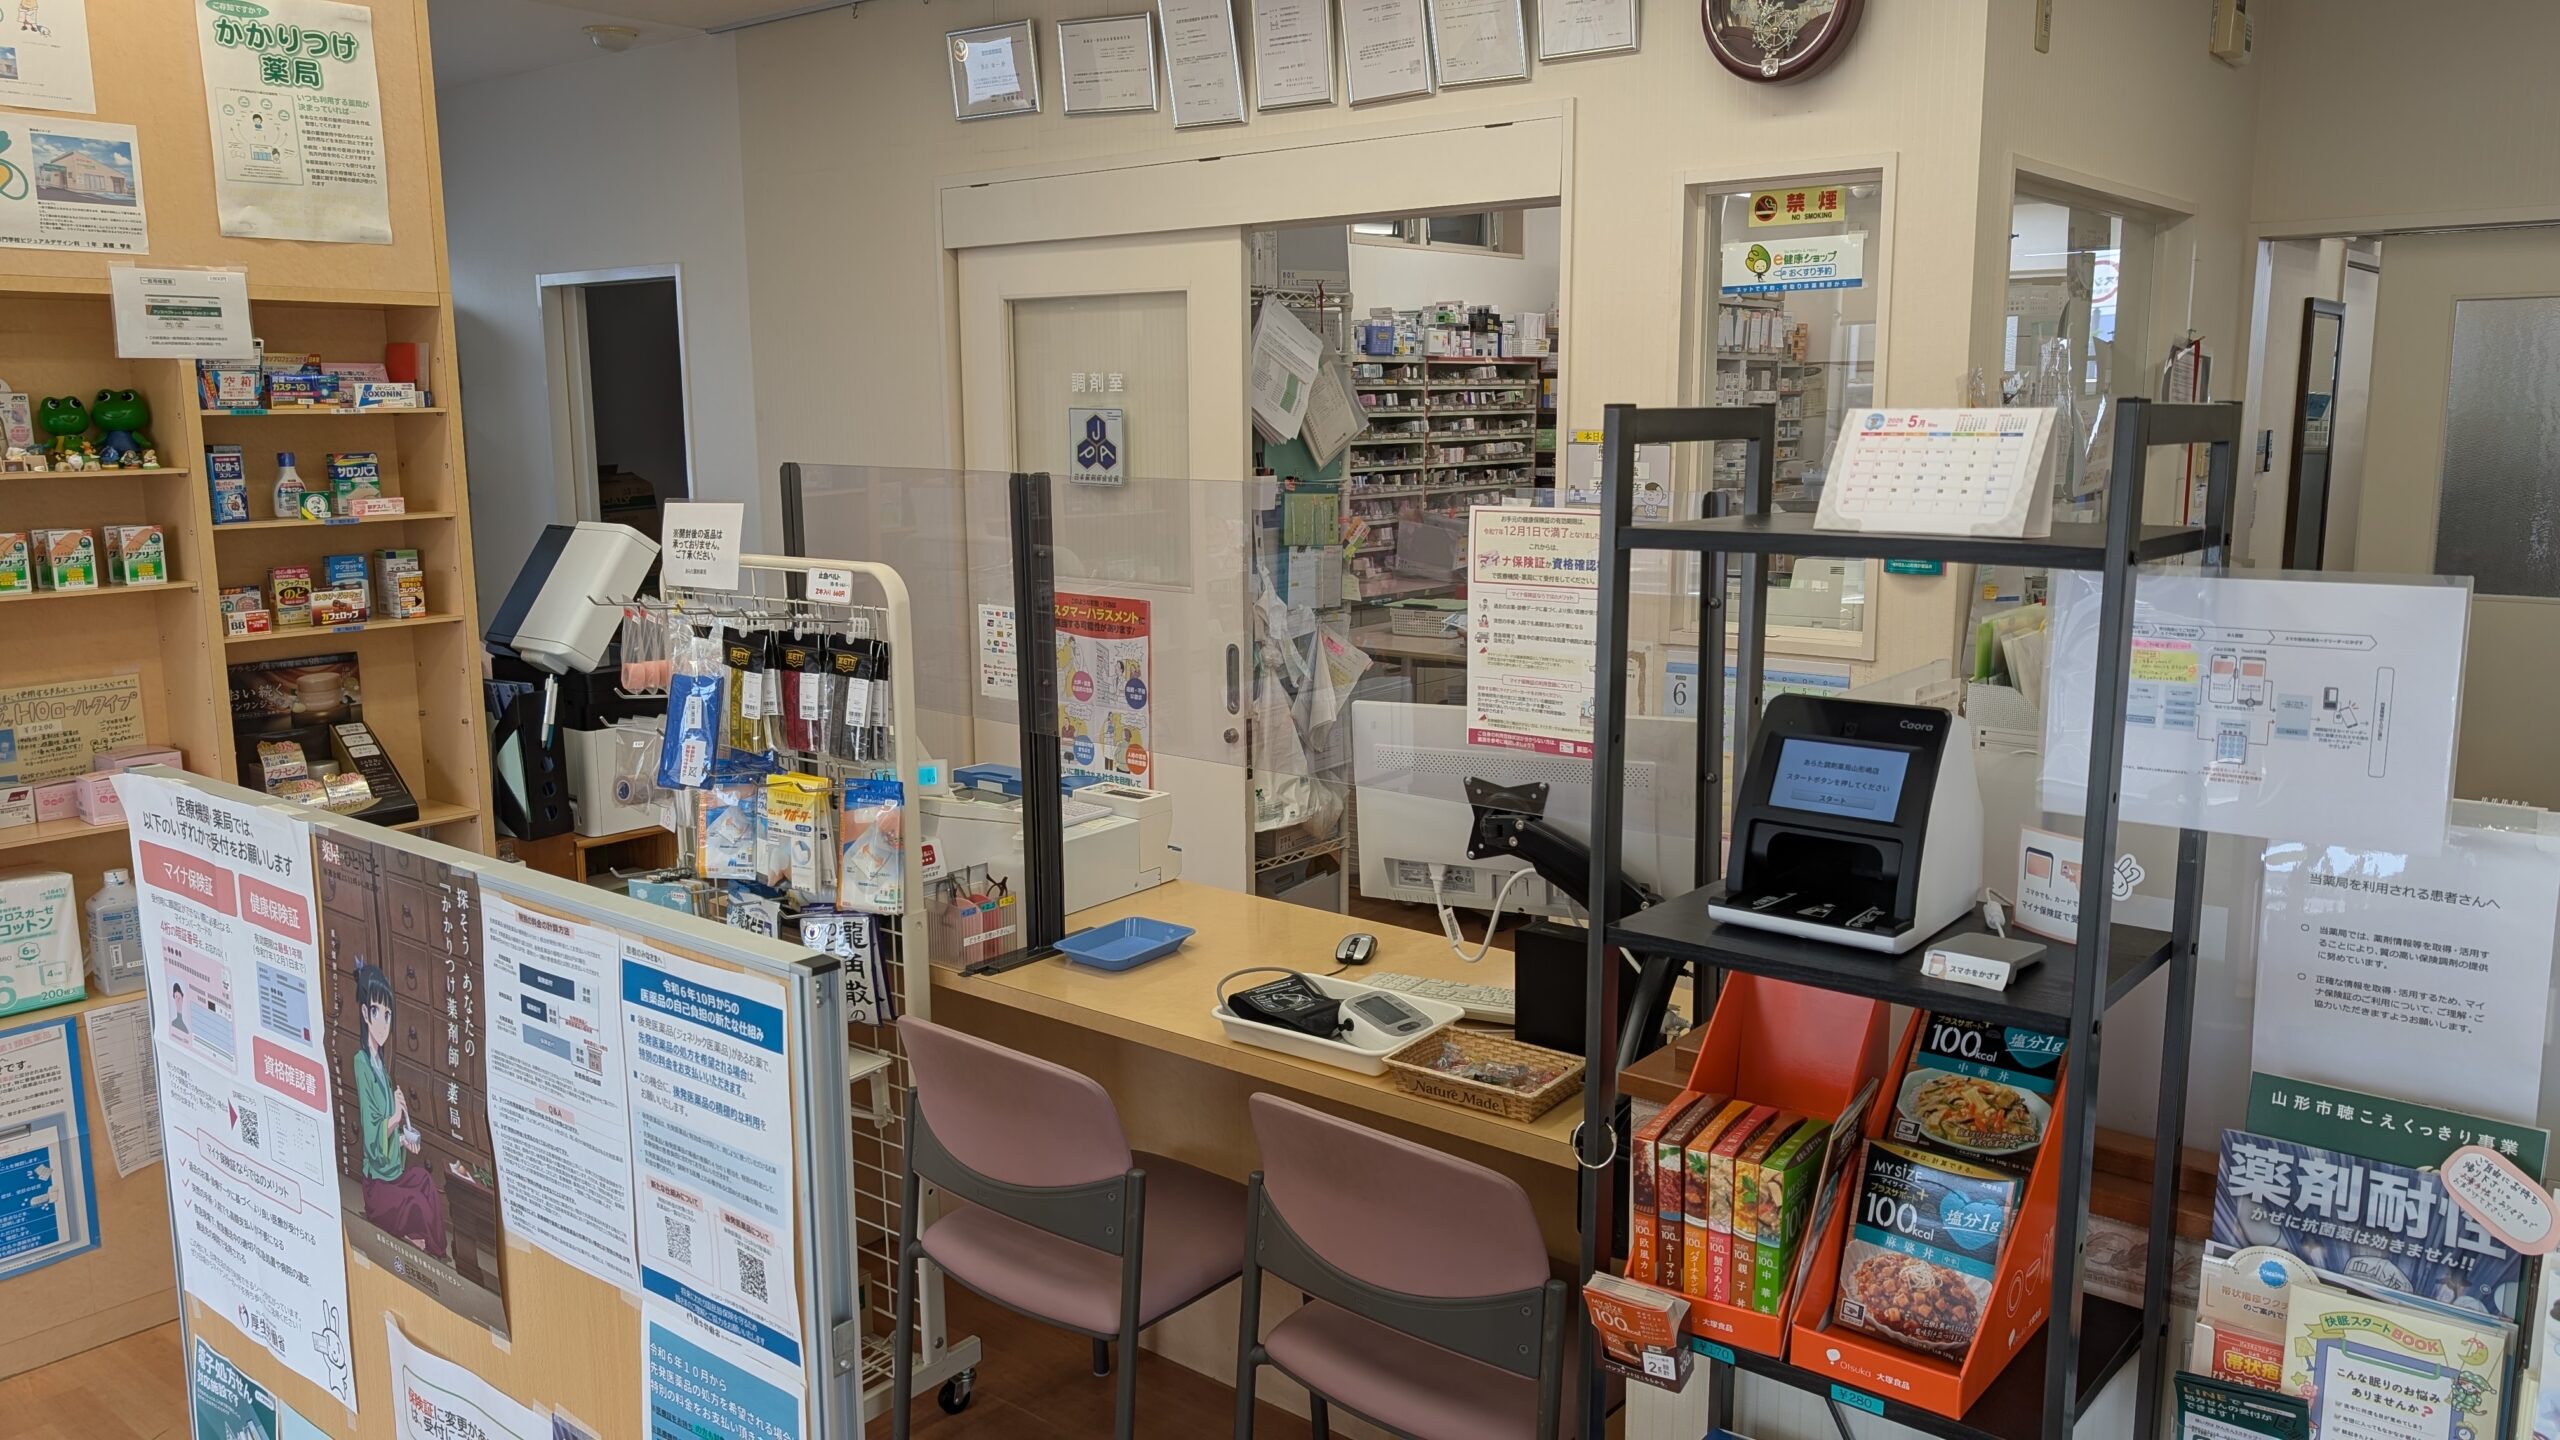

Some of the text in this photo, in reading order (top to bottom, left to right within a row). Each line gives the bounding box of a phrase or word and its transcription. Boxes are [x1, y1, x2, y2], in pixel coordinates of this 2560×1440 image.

[215, 18, 357, 60] かかりつけ
[261, 55, 321, 87] 薬局
[1786, 190, 1838, 213] 禁煙
[1804, 212, 1833, 221] SMOKING
[1773, 250, 1838, 266] e健康ショップ
[1282, 271, 1296, 279] BOX
[1788, 266, 1833, 278] おくすり予約
[1282, 279, 1300, 287] FILE
[1071, 372, 1124, 393] 調剤室
[363, 390, 402, 398] LOXONIN
[1907, 415, 1927, 428] 5月
[338, 466, 377, 478] サロンパス
[1501, 516, 1586, 525] お手元の健康保険証の有効期限は、
[672, 528, 723, 540] ※開封後の返品は
[672, 540, 720, 550] 承っておりません。
[675, 550, 717, 561] ご了承ください。
[1528, 543, 1559, 551] これからは、
[1479, 554, 1600, 571] マイナ保険証か資格確認
[284, 588, 307, 600] のど
[231, 621, 245, 630] BB
[731, 648, 750, 660] ZETT
[786, 650, 805, 662] ZETT
[836, 655, 857, 666] ZETT
[1673, 681, 1687, 706] 6
[1900, 720, 1934, 731] Caora
[265, 766, 306, 778] プラセンタ
[1786, 773, 1890, 792] スタートボタンを押してください
[1819, 795, 1847, 805] スタート
[163, 861, 214, 897] マイナ保険証
[2309, 873, 2501, 909] 当薬局を利用される患者さんへ
[250, 892, 301, 930] 健康保険証
[2319, 926, 2489, 959] 当薬局では、薬剤情報等を取得・活用す
[2317, 951, 2388, 970] に努めています。
[2318, 938, 2489, 973] ることにより、質の高い保険調剤の提供
[455, 888, 476, 1057] 探そう、あなたの
[1950, 965, 2001, 981] スマホをかざす
[662, 980, 740, 1016] 令和6年10月からの
[2316, 975, 2485, 1010] 正確な情報を取得・活用するため、マイ
[640, 989, 765, 1042] 医薬品の自己負担の新たな仕組み
[2315, 987, 2485, 1024] ナ保険証のご利用について、ご理解・ご
[2314, 1000, 2473, 1034] 協力いただきますようお願いします。
[1931, 1023, 1998, 1063] 100kcal
[2008, 1034, 2065, 1053] 塩分1g
[263, 1054, 317, 1097] 資格確認書
[638, 1049, 747, 1099] 特別の料金をお支払いいただきます。
[1958, 1062, 2010, 1083] 中華丼
[1412, 1078, 1501, 1113] Nature Made
[548, 1104, 563, 1118] Q&A
[2271, 1091, 2520, 1156] 山形市聴こえくっきり事業
[1874, 1159, 1894, 1174] MY
[1903, 1151, 1974, 1175] 健康は、計算できる。
[1871, 1182, 1919, 1202] プラスサポート
[1881, 1177, 1911, 1191] マイサイズ
[2228, 1142, 2507, 1260] 薬剤耐性
[1867, 1192, 1935, 1241] 100kcal
[1945, 1209, 2001, 1233] 塩分1g
[1885, 1235, 1935, 1259] 麻婆丼
[2250, 1207, 2477, 1272] かぜに抗菌薬は効きません!!
[2352, 1259, 2403, 1291] 血小板
[251, 1313, 286, 1352] 厚生労働省
[1702, 1317, 1734, 1333] 大塚食品
[2324, 1315, 2439, 1353] 快眠スタートBOOK
[1840, 1361, 1911, 1391] Otsuka 大塚食品
[2337, 1368, 2441, 1404] こんな眠りのお悩み
[1839, 1388, 1872, 1409] ¥280
[2183, 1386, 2227, 1402] LINE
[2351, 1387, 2434, 1418] ありませんか？
[2184, 1394, 2273, 1421] 処方せんの受付が
[2186, 1401, 2236, 1421] できます！
